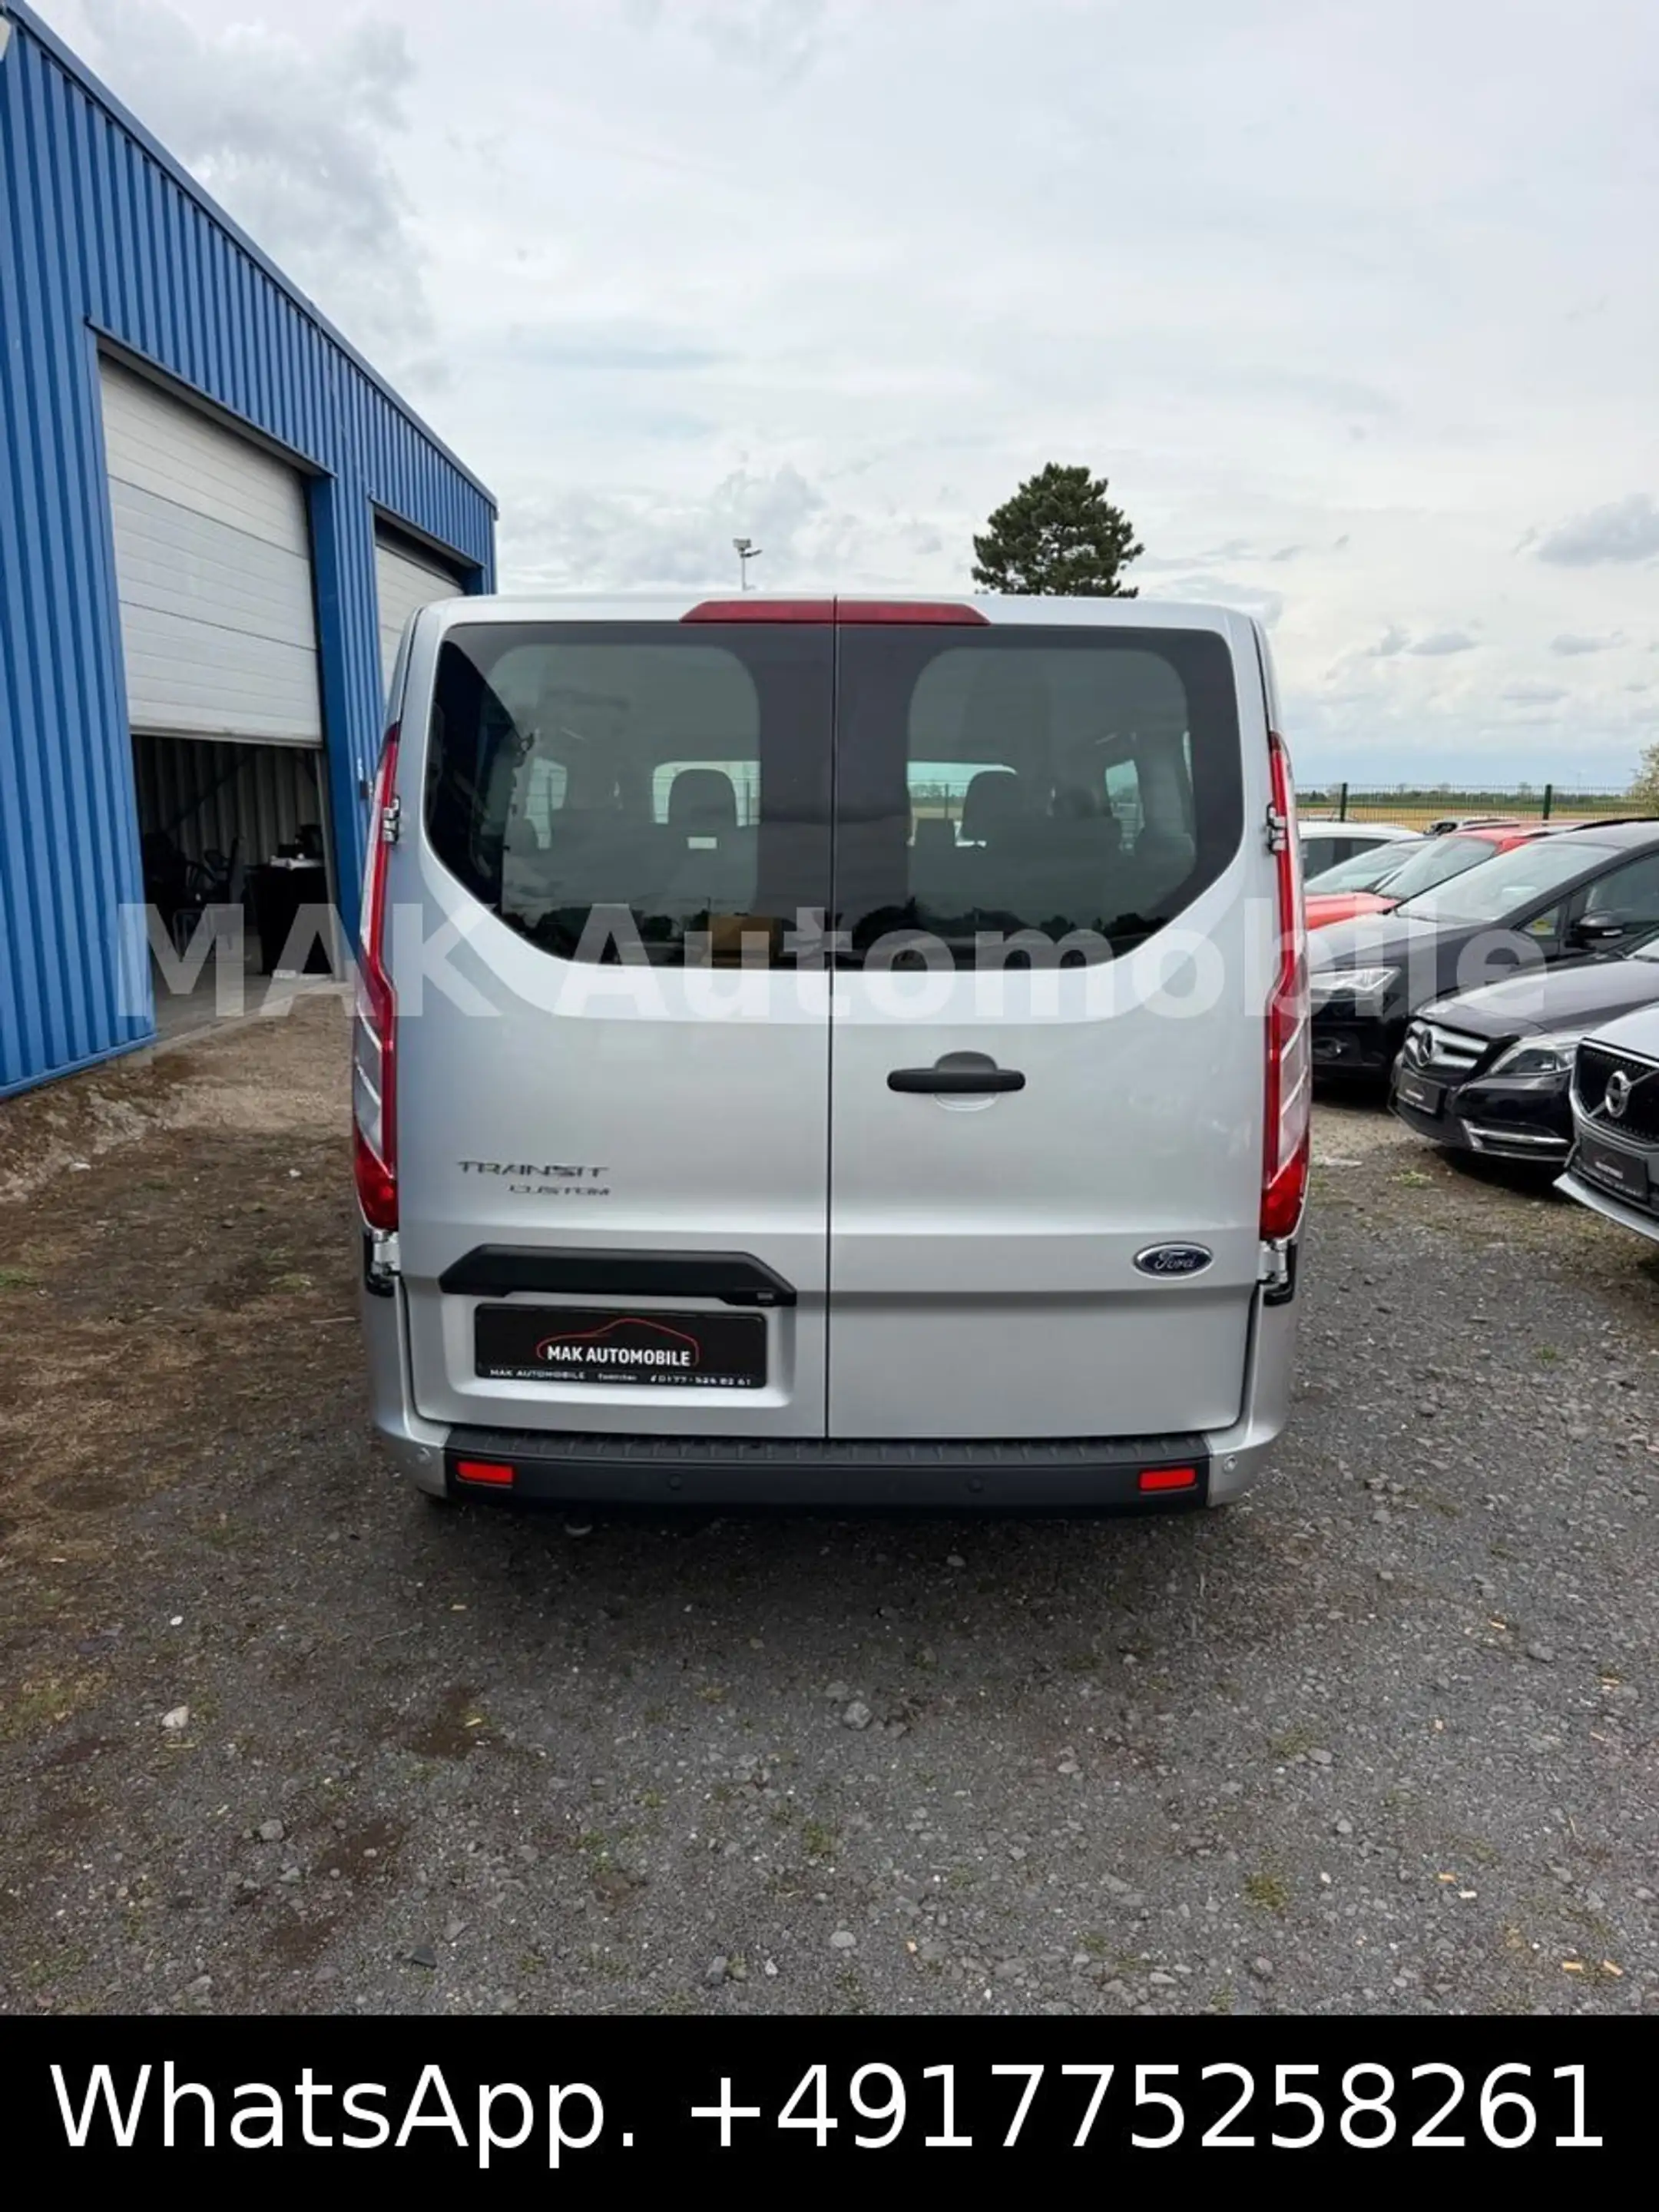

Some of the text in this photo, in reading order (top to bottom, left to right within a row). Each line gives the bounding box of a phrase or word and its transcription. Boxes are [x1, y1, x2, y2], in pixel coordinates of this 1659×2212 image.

[456, 1161, 611, 1178] TRANSIT
[508, 1184, 611, 1197] CUSTOM
[1154, 1250, 1197, 1270] Ford
[547, 1346, 690, 1367] MAK AUTOMOBILE
[516, 1369, 586, 1380] AUTOMOBILE
